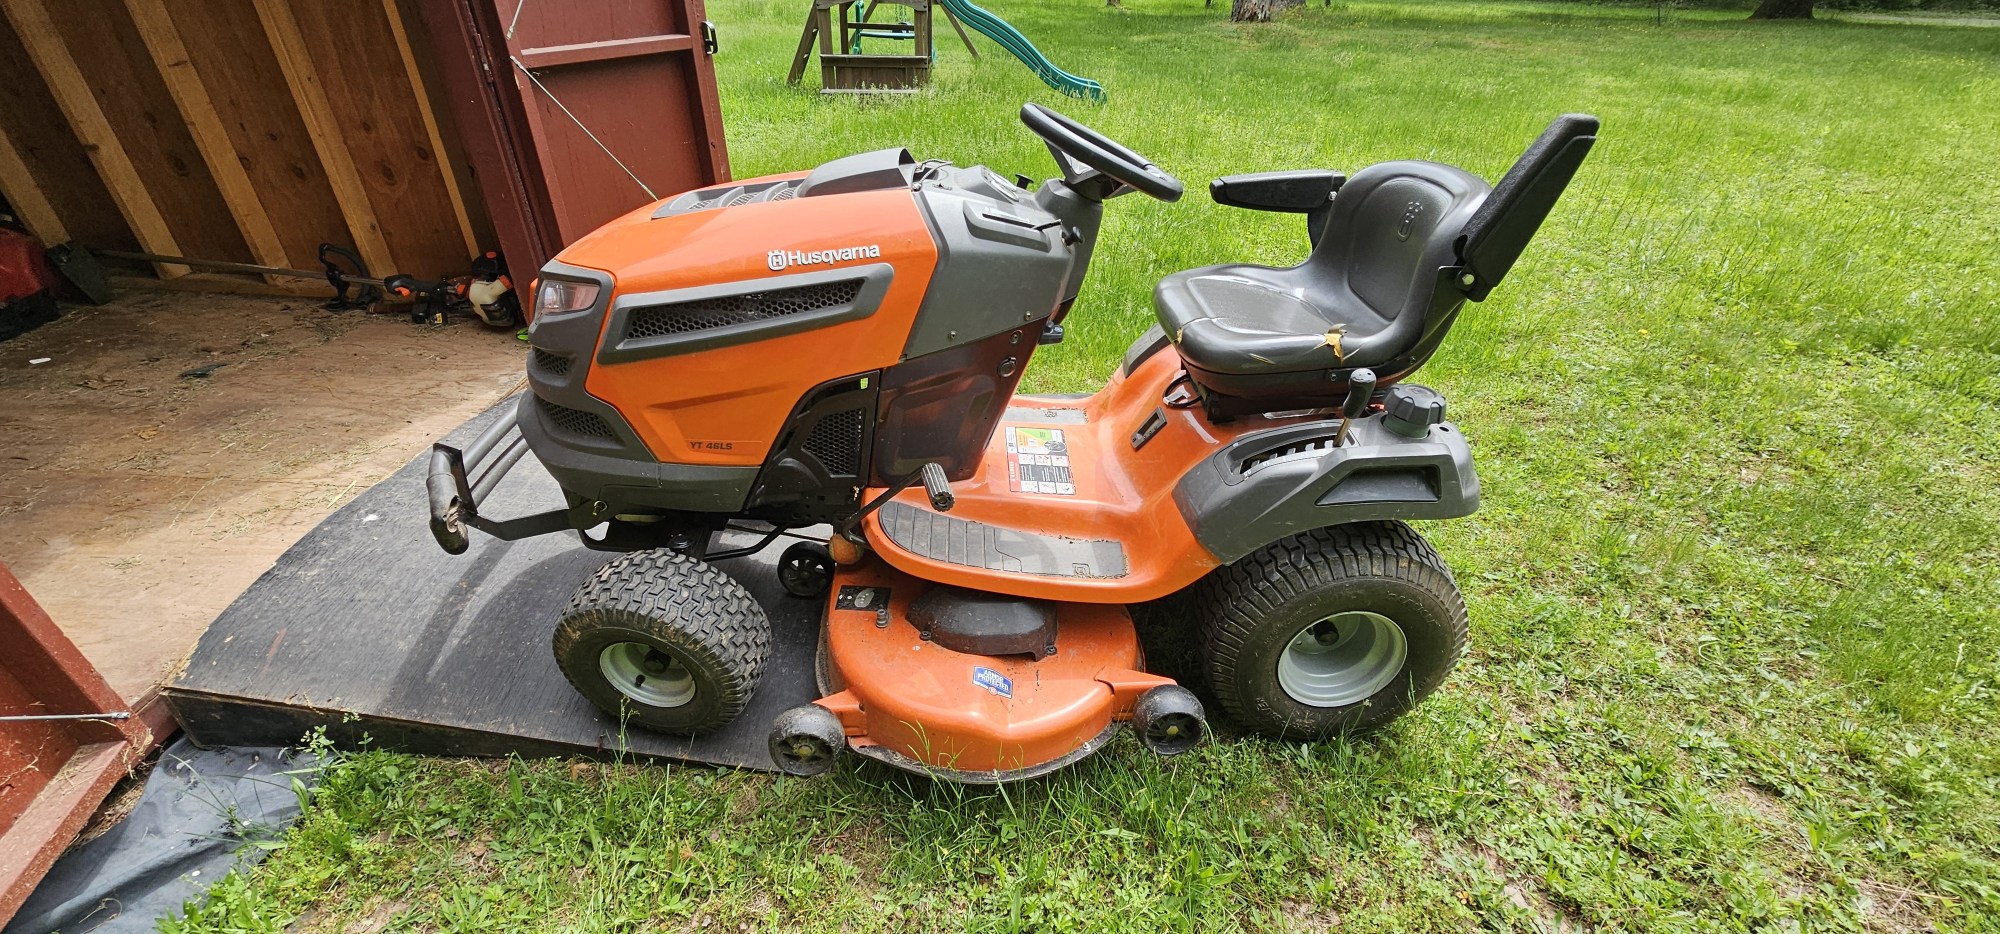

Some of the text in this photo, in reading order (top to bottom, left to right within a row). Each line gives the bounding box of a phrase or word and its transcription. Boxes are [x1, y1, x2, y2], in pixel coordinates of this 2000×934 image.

[788, 244, 881, 266] Husqvarna
[690, 441, 703, 449] YT
[977, 673, 1009, 691] PROTECTED
